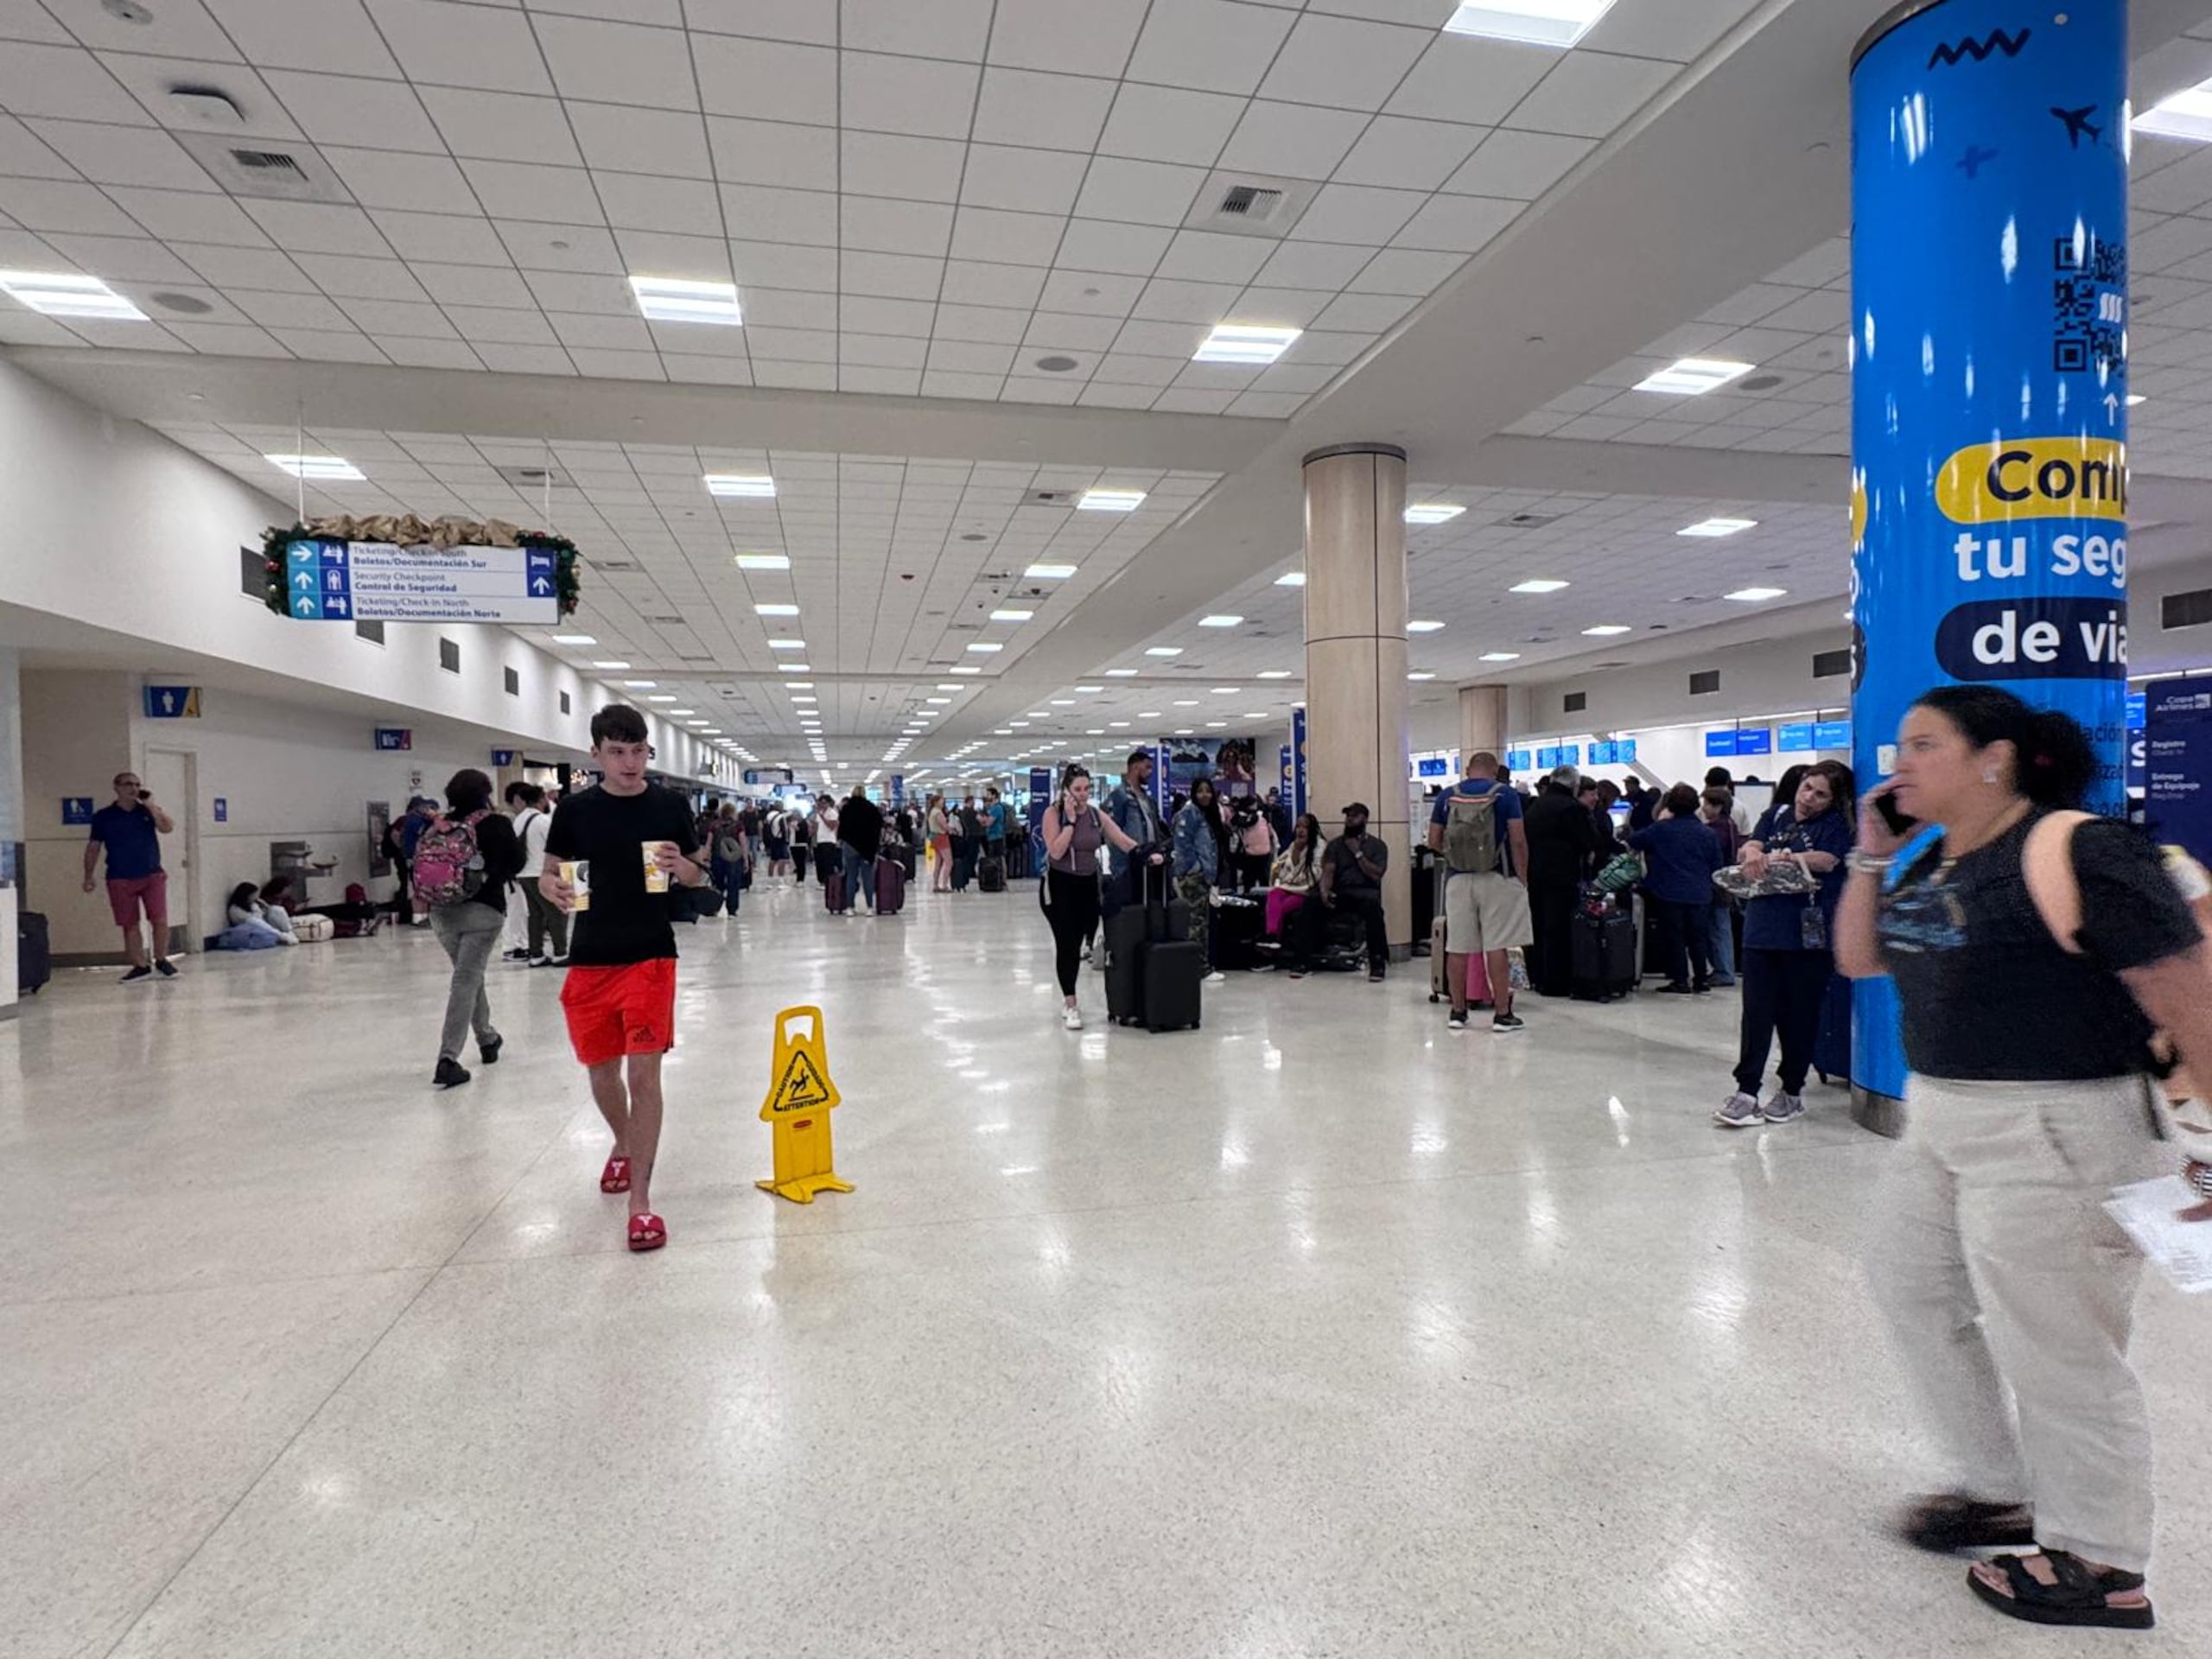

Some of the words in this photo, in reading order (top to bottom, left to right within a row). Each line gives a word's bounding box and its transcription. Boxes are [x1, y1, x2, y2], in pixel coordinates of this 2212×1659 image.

[1954, 532, 2026, 581] tu
[471, 559, 486, 568] Sur
[353, 572, 391, 582] Security
[393, 572, 445, 582] Checkpoint
[355, 582, 391, 591] Control
[393, 582, 406, 591] de
[408, 583, 457, 594] Seguridad
[442, 599, 469, 607] North
[474, 609, 501, 619] Norte
[1972, 610, 2060, 664] de
[2165, 696, 2194, 704] Copa
[2155, 702, 2195, 712] Airlines
[2152, 781, 2163, 790] de
